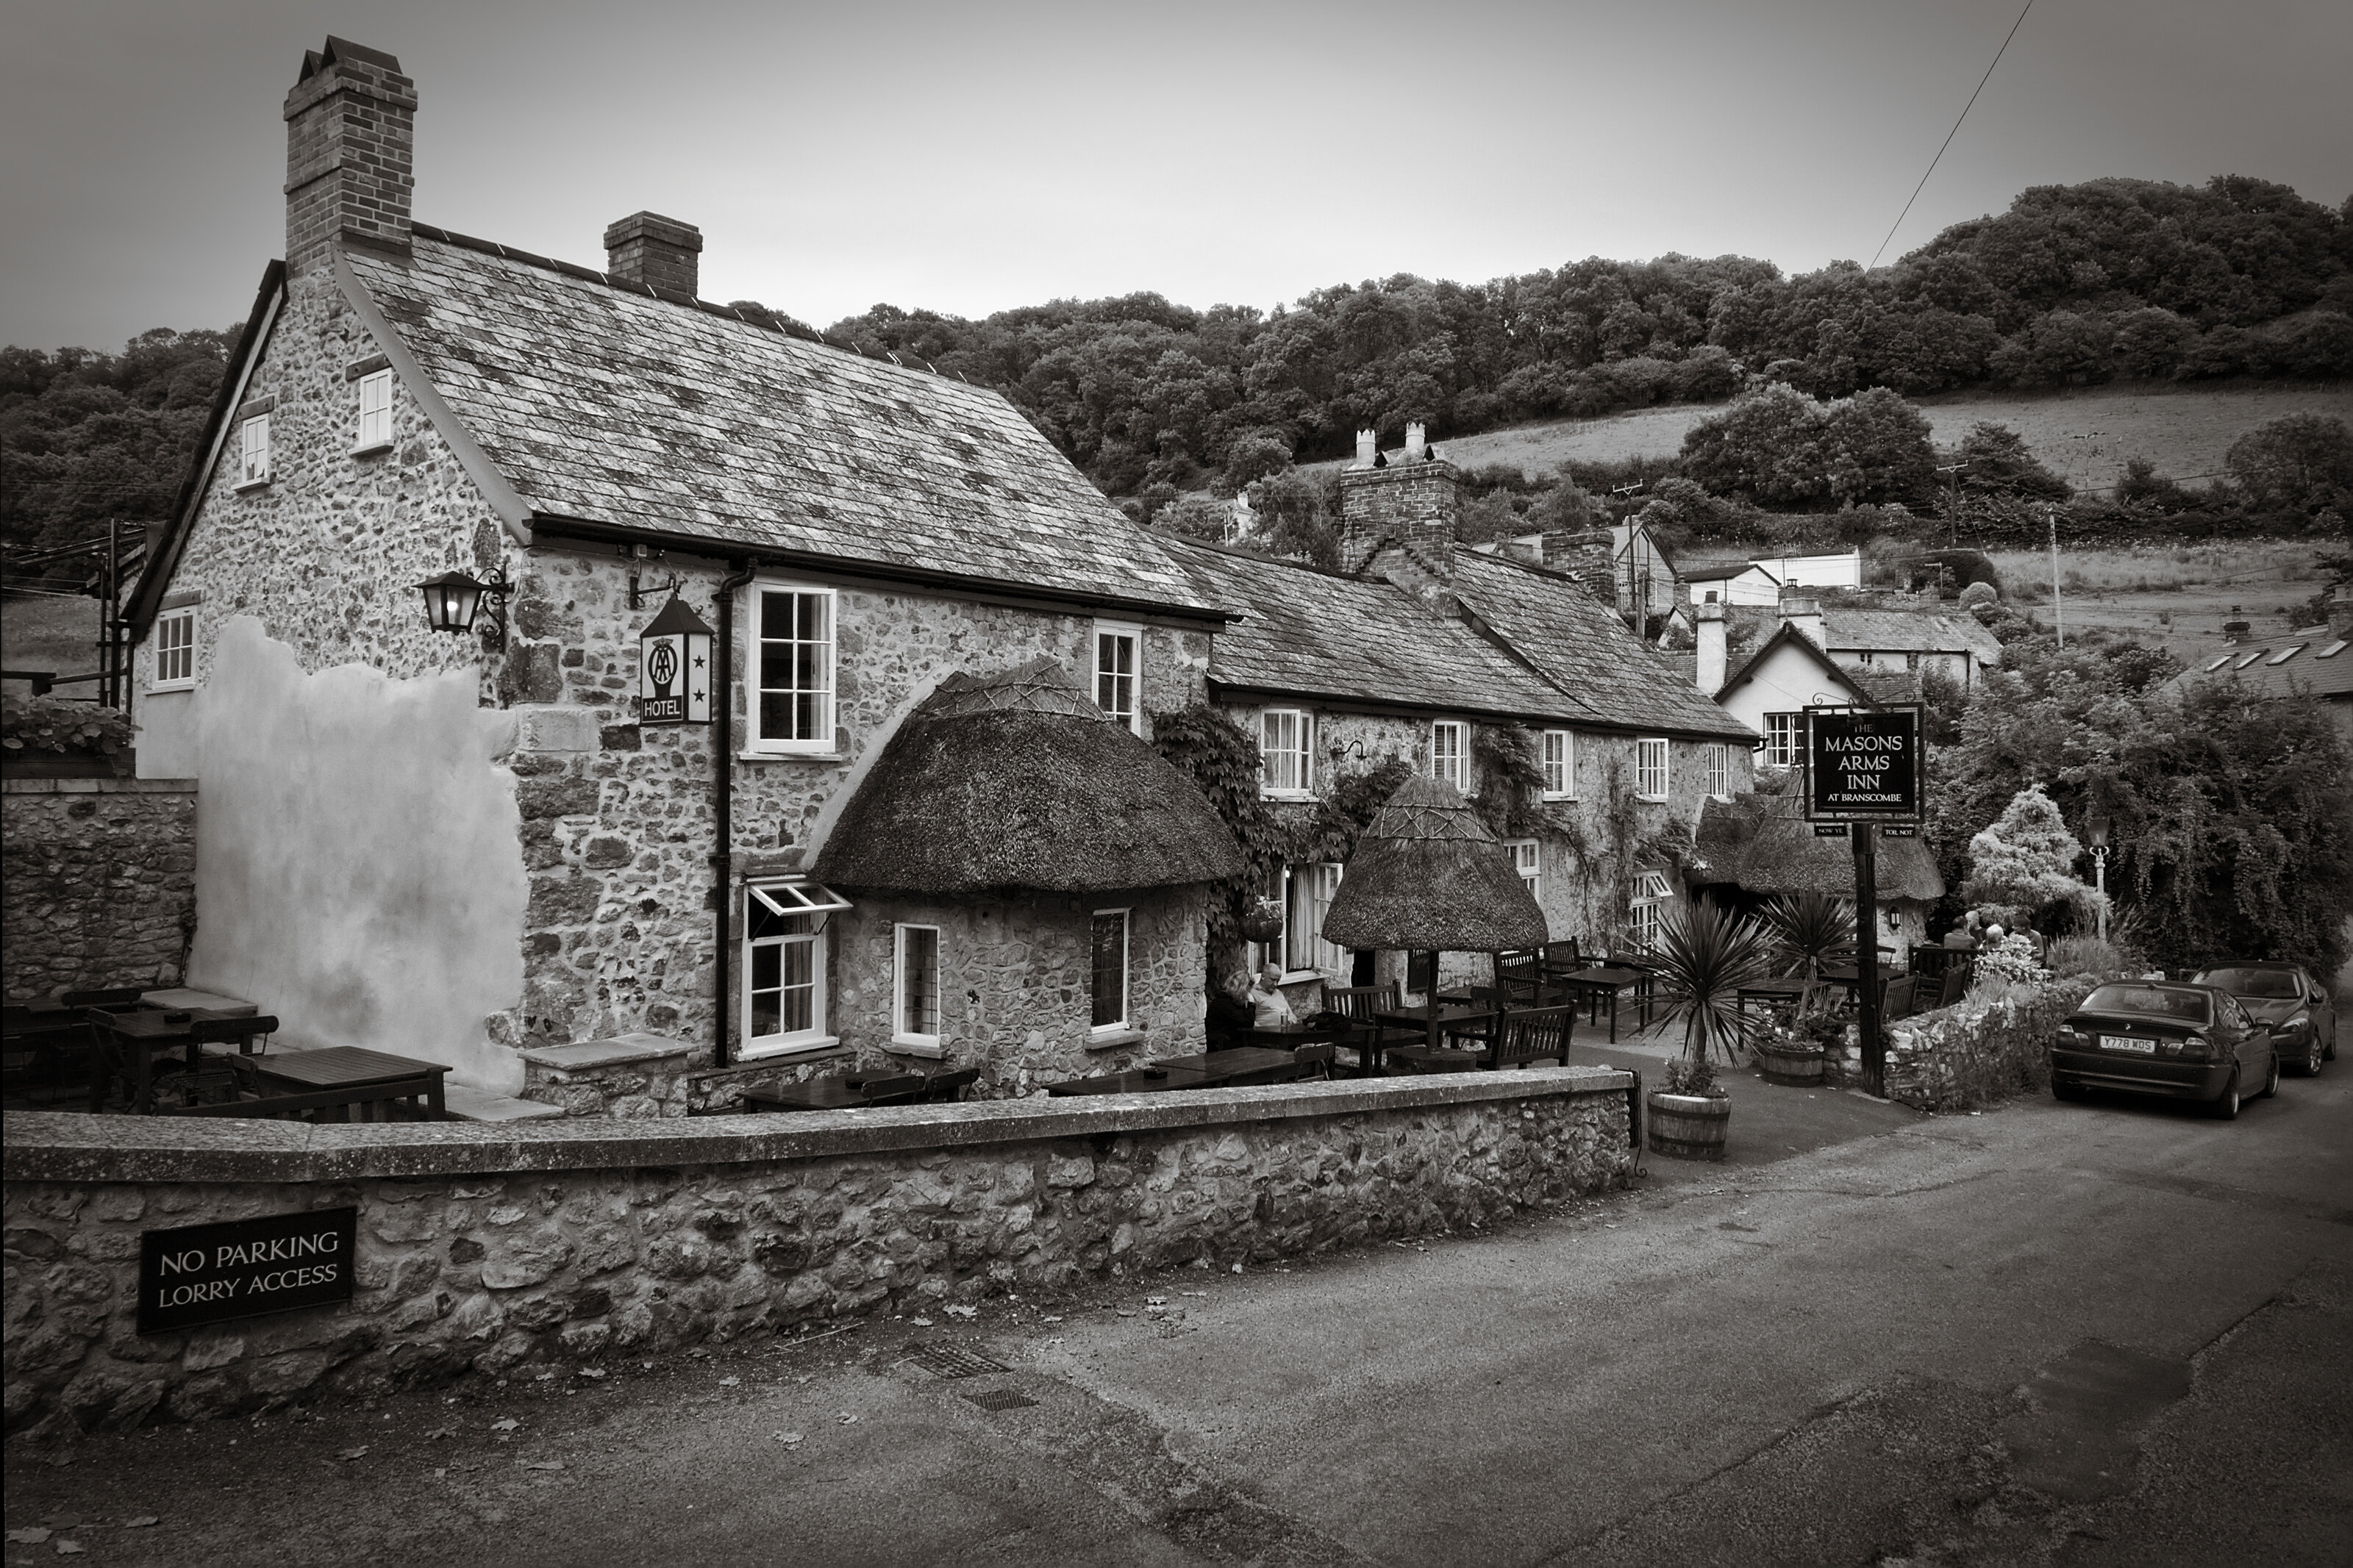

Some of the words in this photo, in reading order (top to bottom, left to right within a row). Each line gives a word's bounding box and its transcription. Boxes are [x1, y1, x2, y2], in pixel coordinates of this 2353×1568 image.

[644, 700, 680, 716] HOTEL
[1825, 736, 1903, 751] MASONS
[1838, 756, 1890, 770] ARMS
[1847, 775, 1881, 790] INN
[1827, 794, 1840, 802] AT
[1841, 793, 1902, 802] BRANSCOMBE
[2104, 1037, 2129, 1048] Y778
[2132, 1040, 2152, 1050] WDS
[160, 1250, 205, 1276] NO
[216, 1231, 339, 1268] PARKING
[158, 1278, 240, 1309] LORRY
[247, 1264, 338, 1295] ACCESS
